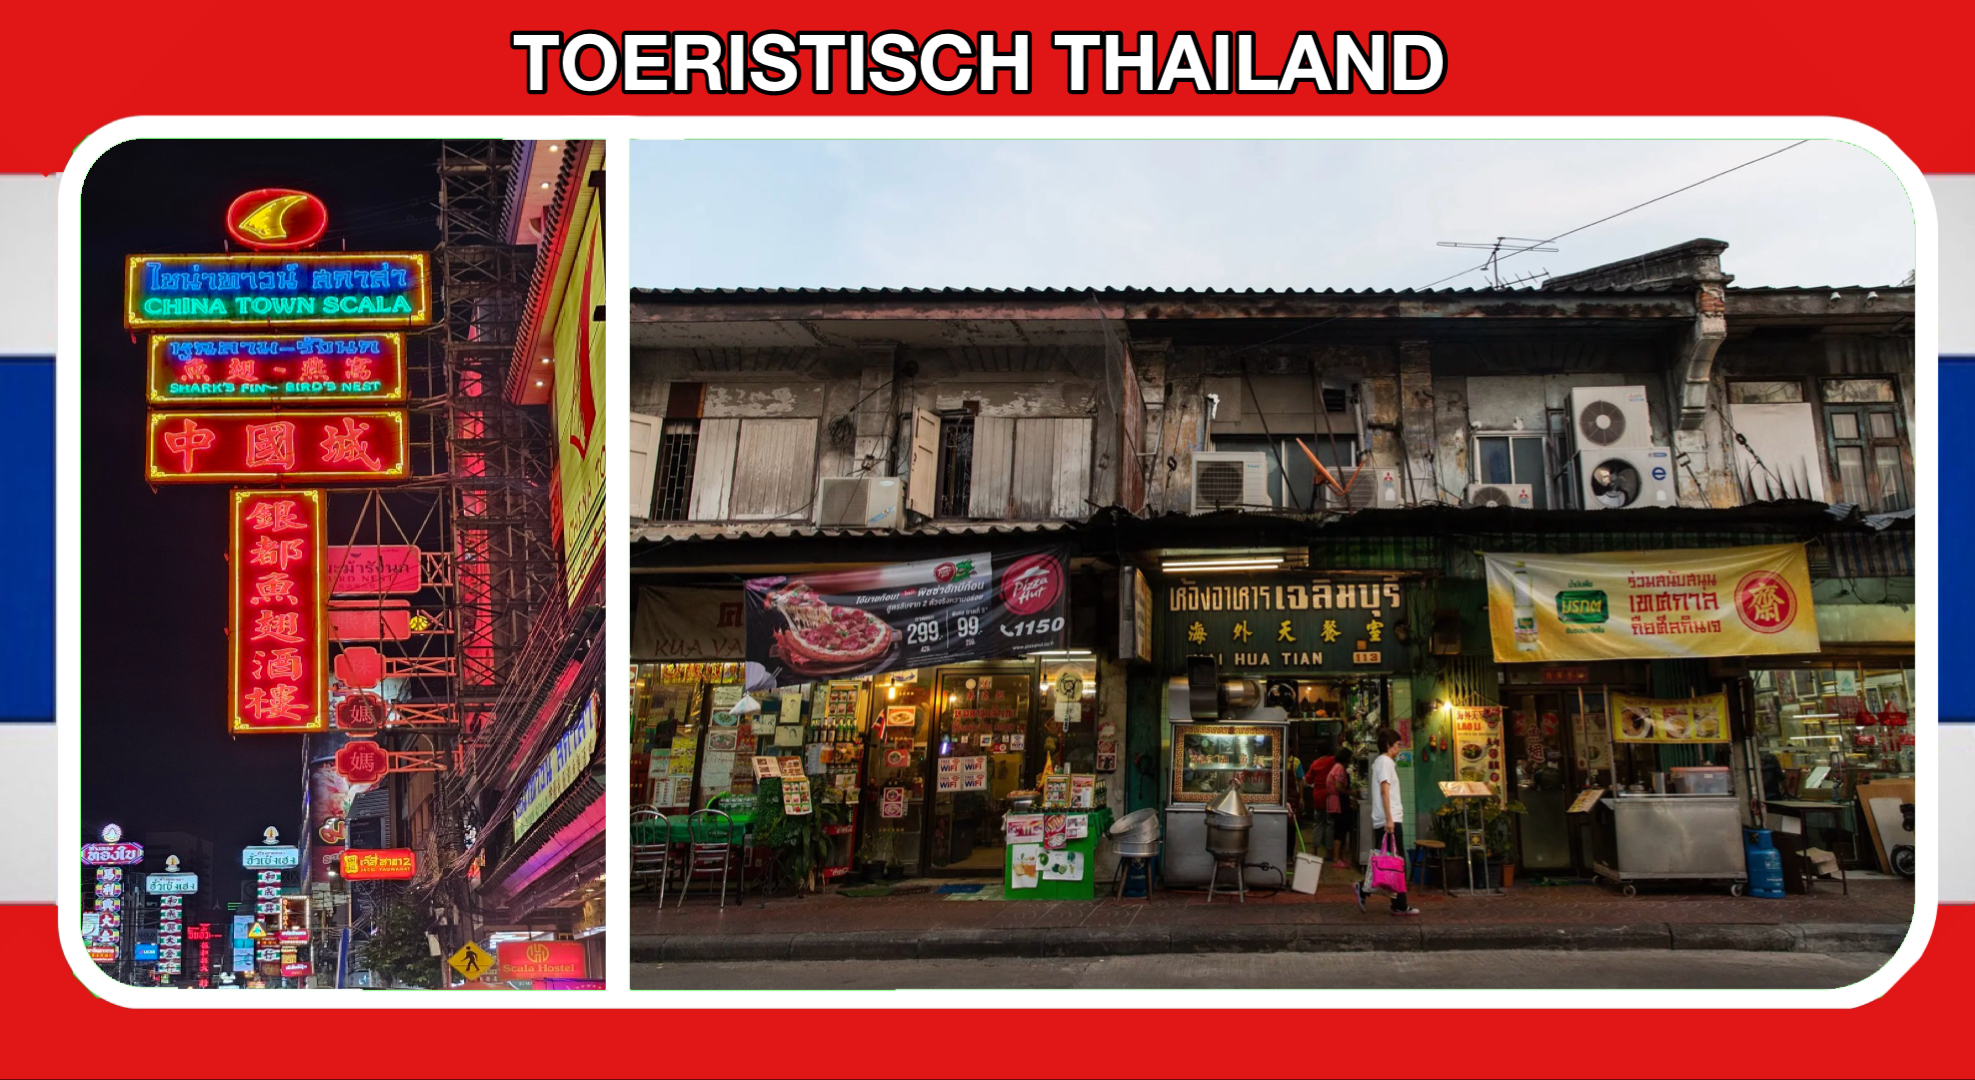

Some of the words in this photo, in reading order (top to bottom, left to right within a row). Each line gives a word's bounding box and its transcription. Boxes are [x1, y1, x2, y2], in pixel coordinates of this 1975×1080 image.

[146, 262, 298, 290] ไชน่าทาวน์
[144, 297, 227, 315] CHINA
[235, 297, 315, 314] TOWN
[322, 295, 412, 314] SCALA
[169, 382, 235, 394] SHARK'S
[285, 381, 336, 392] BIRD'S
[341, 380, 381, 391] NEST
[164, 418, 381, 472] 中國城
[1012, 576, 1048, 598] Pizza
[1627, 570, 1718, 590] ร่วมสนับสนุน
[1018, 586, 1047, 605] Hut
[1169, 577, 1271, 612] ห้องอาหาร
[1275, 574, 1400, 617] เฉลิมบุรี
[1629, 591, 1720, 613] เทศกาล
[244, 500, 309, 721] 銀都魚翅酒樓
[1014, 617, 1065, 636] 1150
[1188, 619, 1385, 646] 海外天餐室
[1631, 614, 1722, 636] ถือศีลกินเจ
[1234, 652, 1271, 666] HUA
[1281, 651, 1323, 665] TIAN
[1355, 653, 1379, 662] 113
[349, 751, 375, 772] 媽
[940, 764, 958, 772] WiFi
[503, 964, 535, 973] Scala
[538, 963, 575, 972] Hostel
